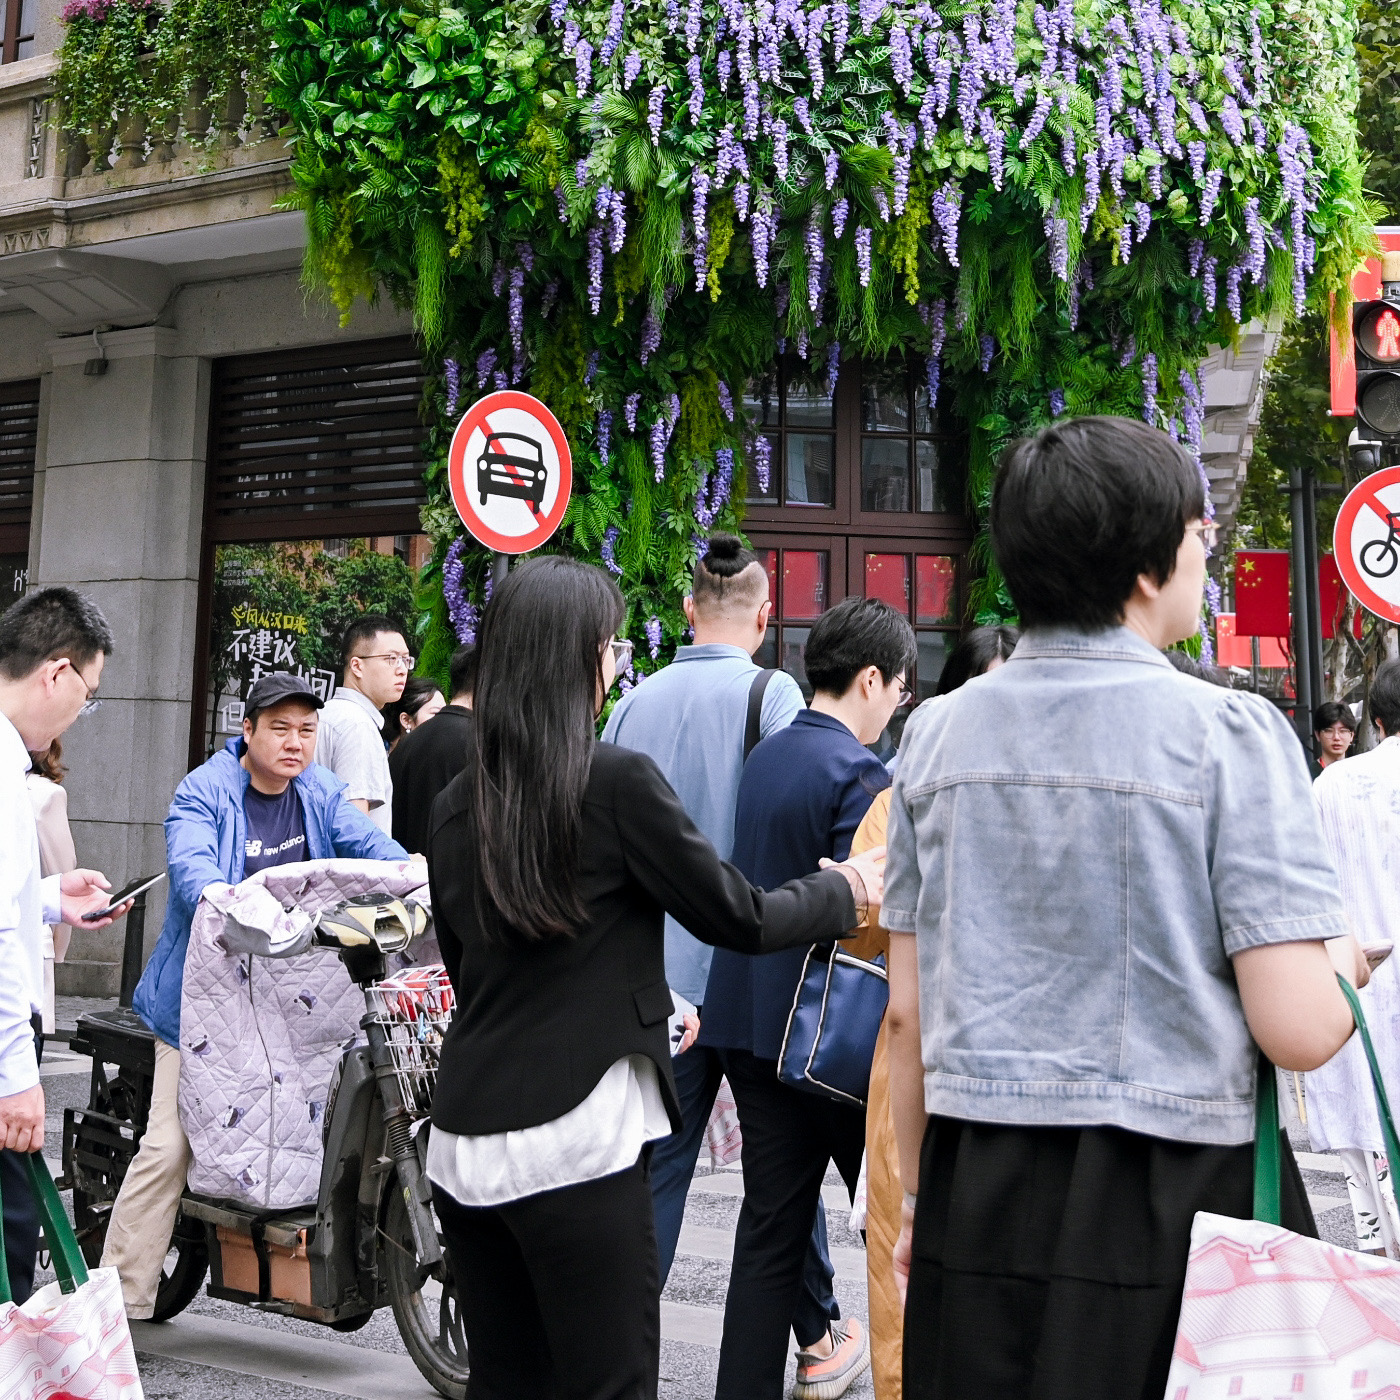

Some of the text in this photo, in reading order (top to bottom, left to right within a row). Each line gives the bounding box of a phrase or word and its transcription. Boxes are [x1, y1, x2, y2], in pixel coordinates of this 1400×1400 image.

[246, 607, 308, 635] 风从汉口来
[227, 628, 297, 667] 不建议
